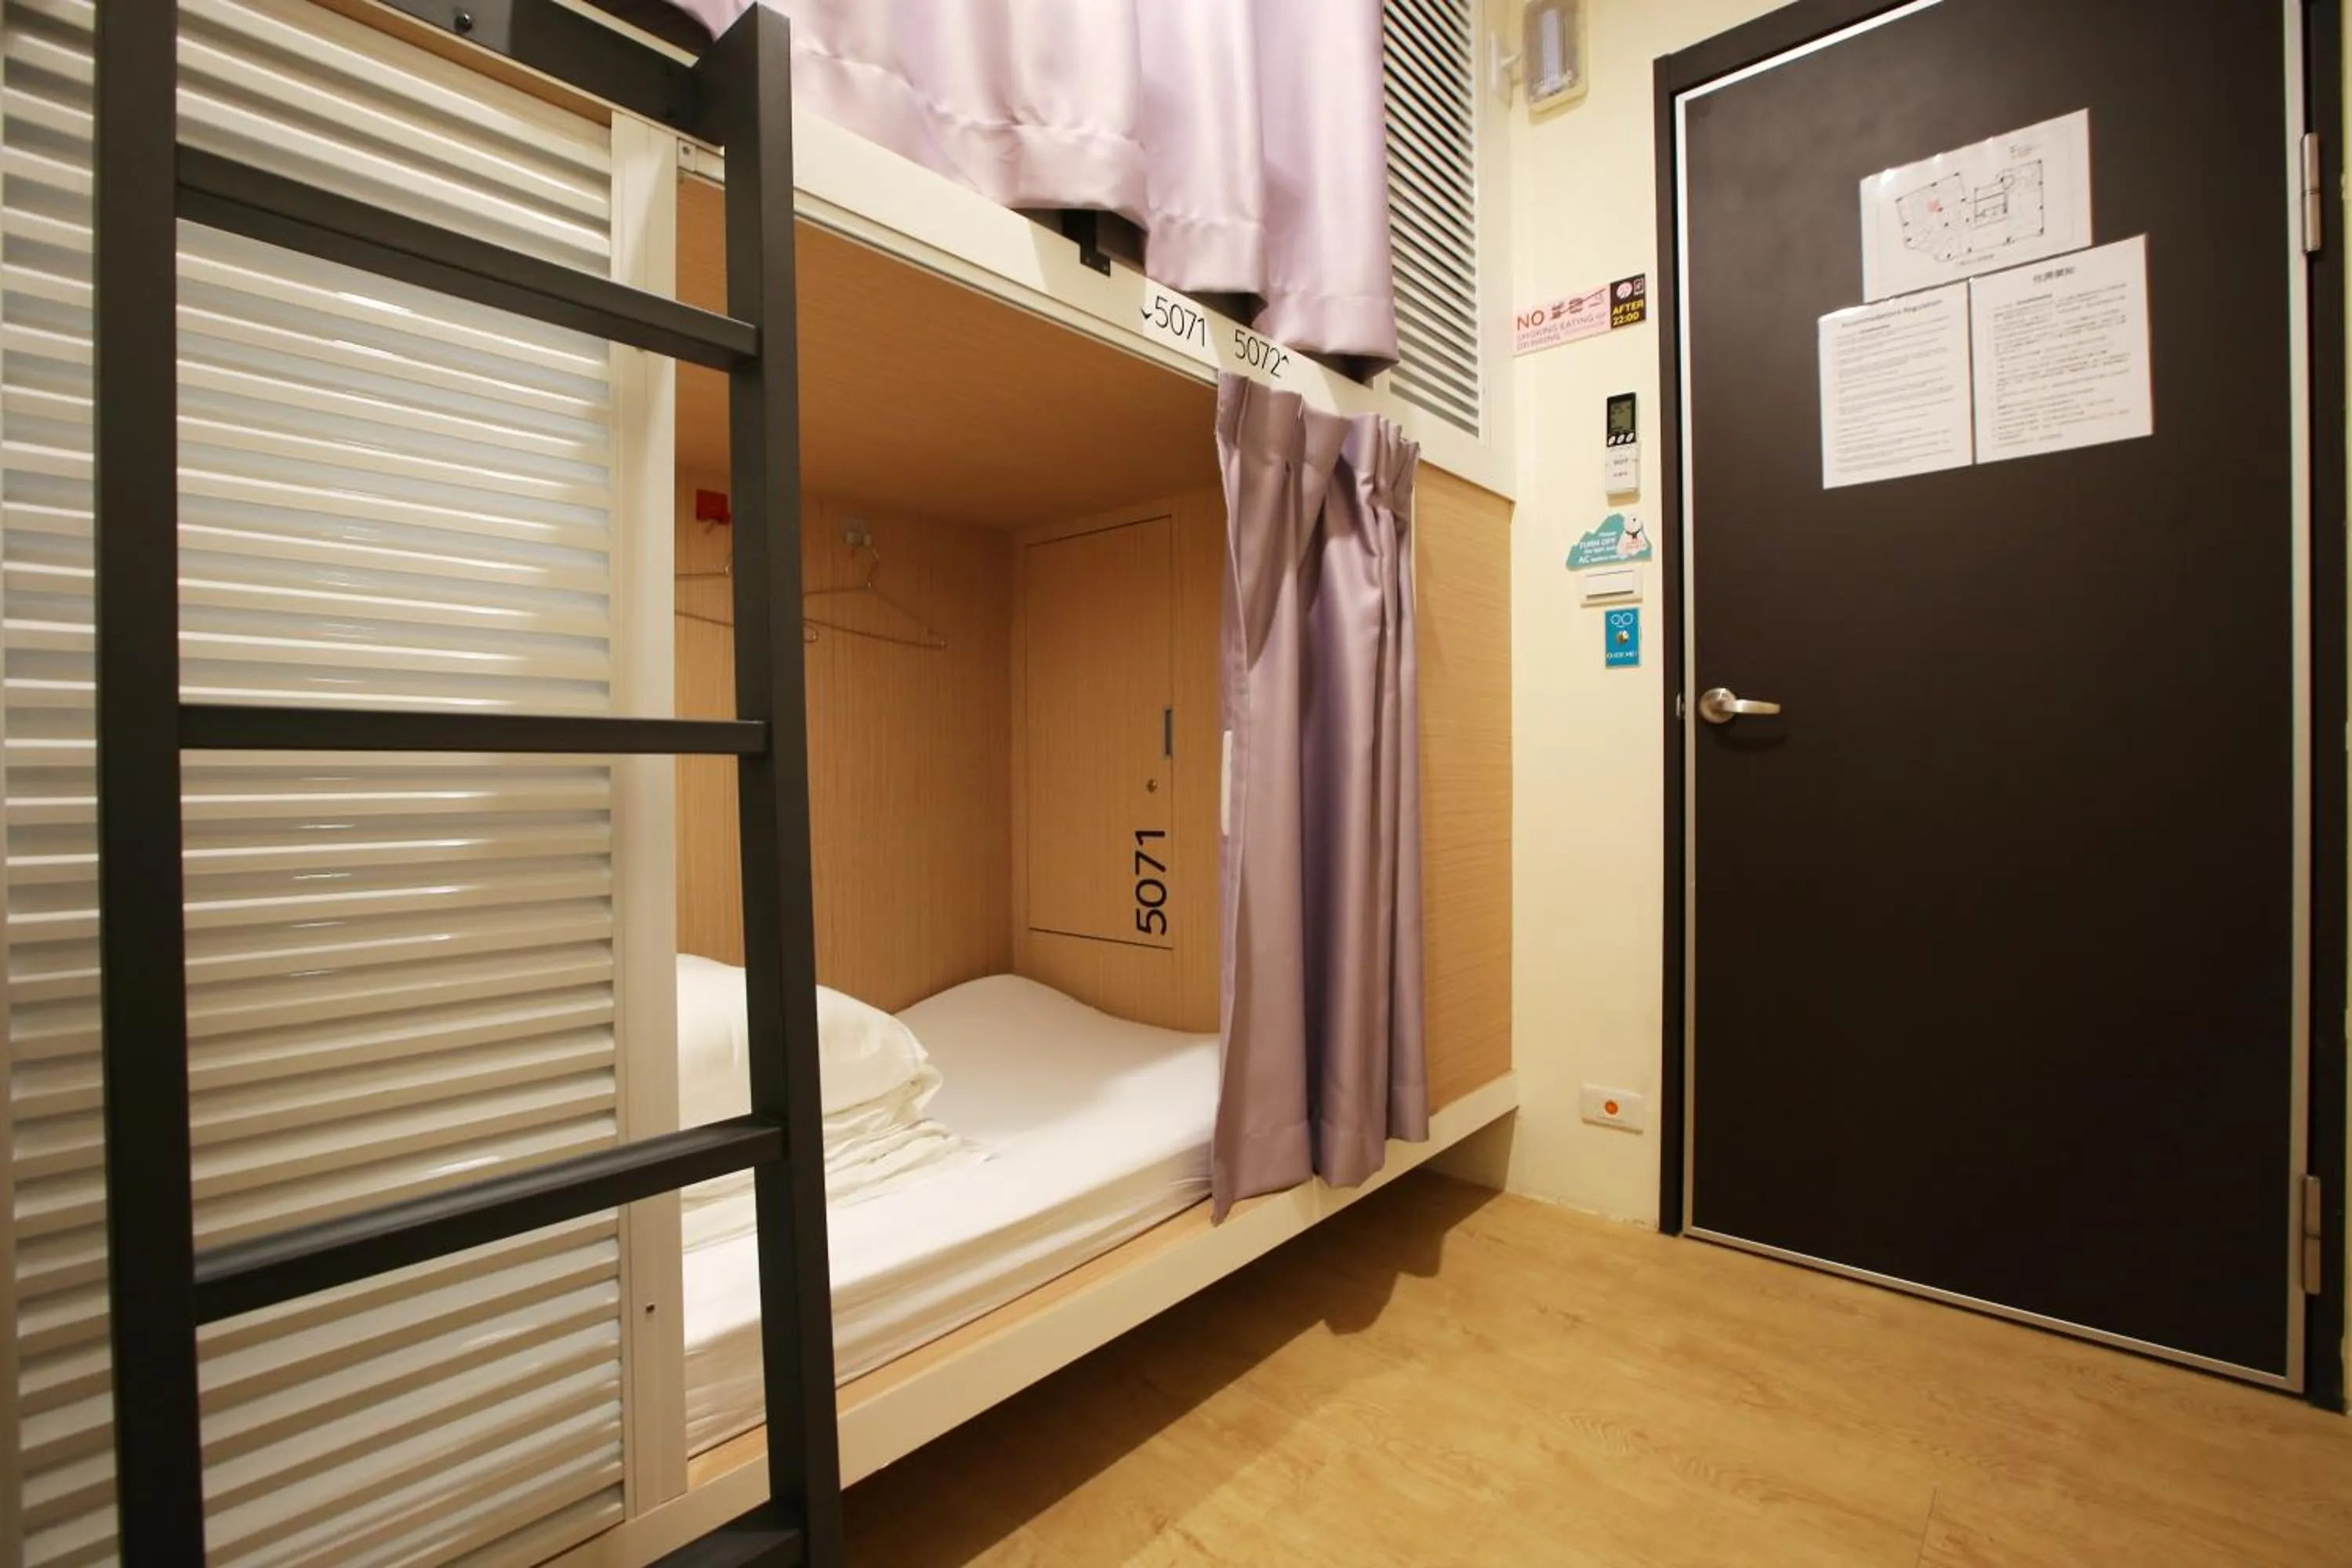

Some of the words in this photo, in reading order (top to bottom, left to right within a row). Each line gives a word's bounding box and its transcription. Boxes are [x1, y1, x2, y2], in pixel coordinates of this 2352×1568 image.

[1155, 296, 1206, 347] 5071
[1517, 310, 1544, 331] NO
[1613, 300, 1644, 315] AFTER
[1613, 312, 1639, 326] 22:00
[1234, 328, 1282, 379] 5072
[1135, 830, 1167, 935] 5071
